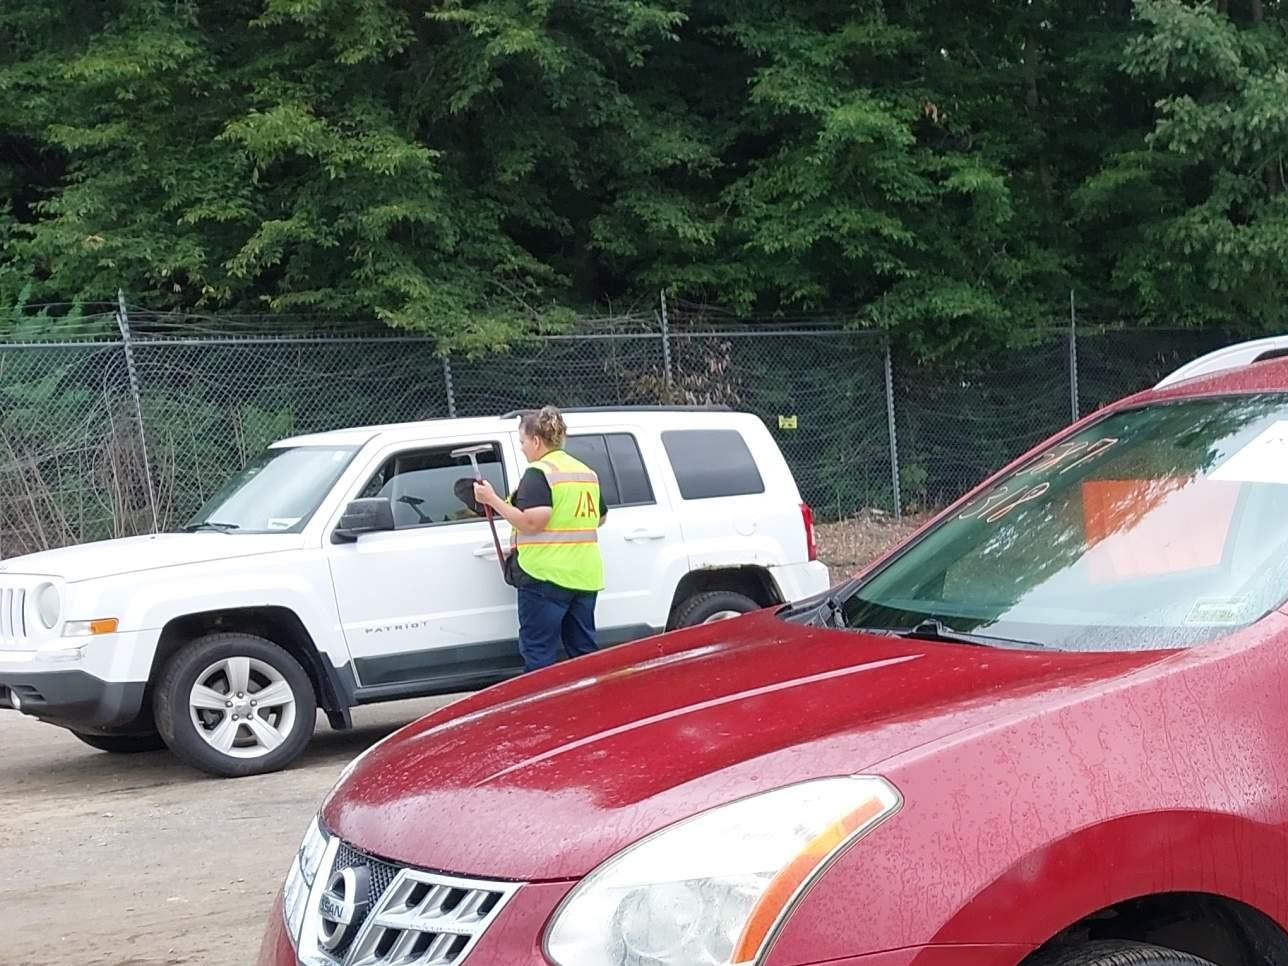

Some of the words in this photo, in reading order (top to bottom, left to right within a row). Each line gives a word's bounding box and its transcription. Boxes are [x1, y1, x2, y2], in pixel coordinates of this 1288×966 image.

[1014, 438, 1119, 476] 587
[959, 486, 1050, 523] 318
[364, 620, 429, 634] PATRIOT
